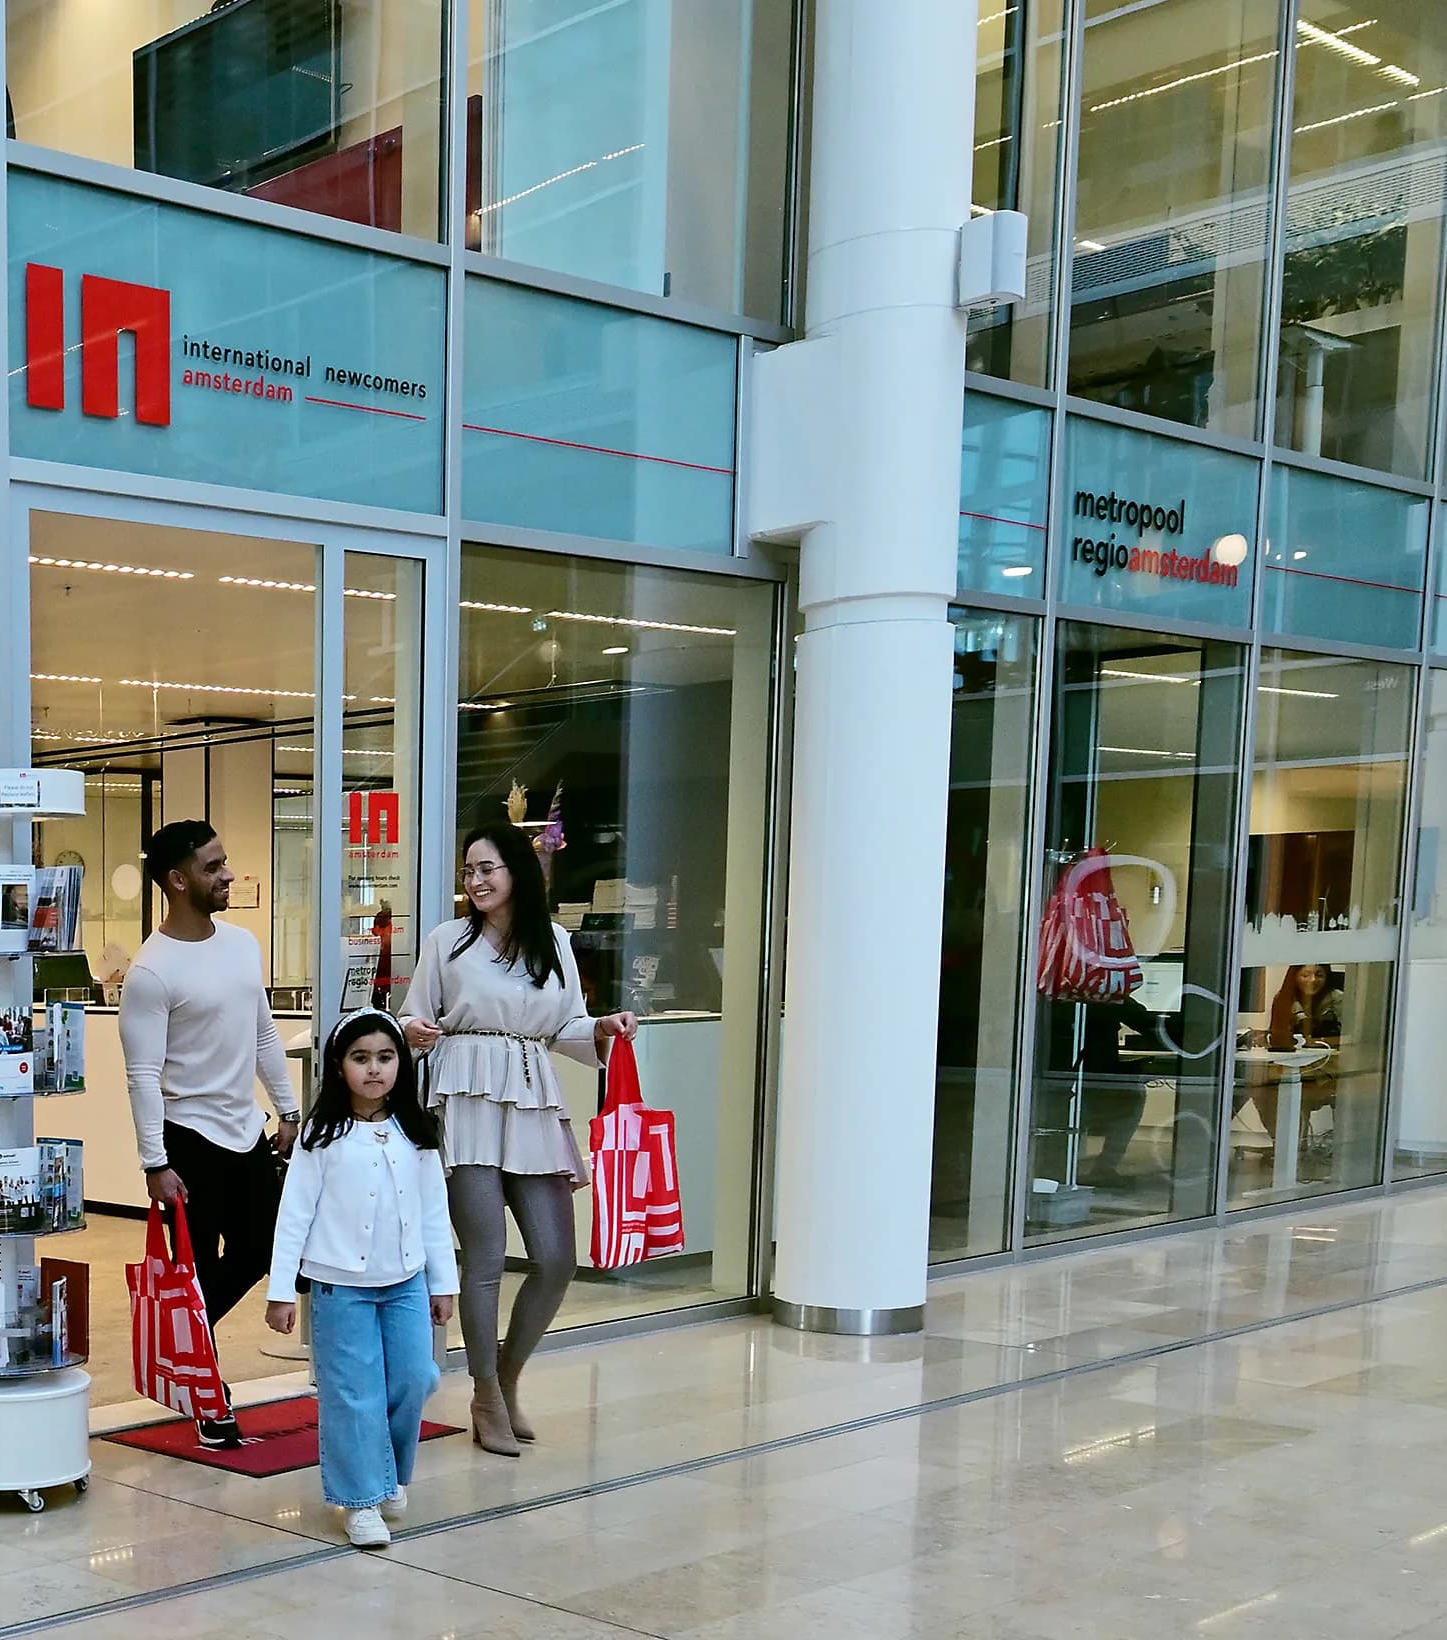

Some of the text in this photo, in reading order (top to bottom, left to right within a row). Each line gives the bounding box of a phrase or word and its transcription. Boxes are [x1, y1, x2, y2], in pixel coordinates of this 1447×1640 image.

[182, 366, 294, 402] amsterdam
[183, 334, 428, 399] international newcomers
[1075, 489, 1186, 538] metropool
[1072, 532, 1240, 588] regioamsterdam
[348, 849, 399, 859] amsterdam
[349, 936, 382, 945] business
